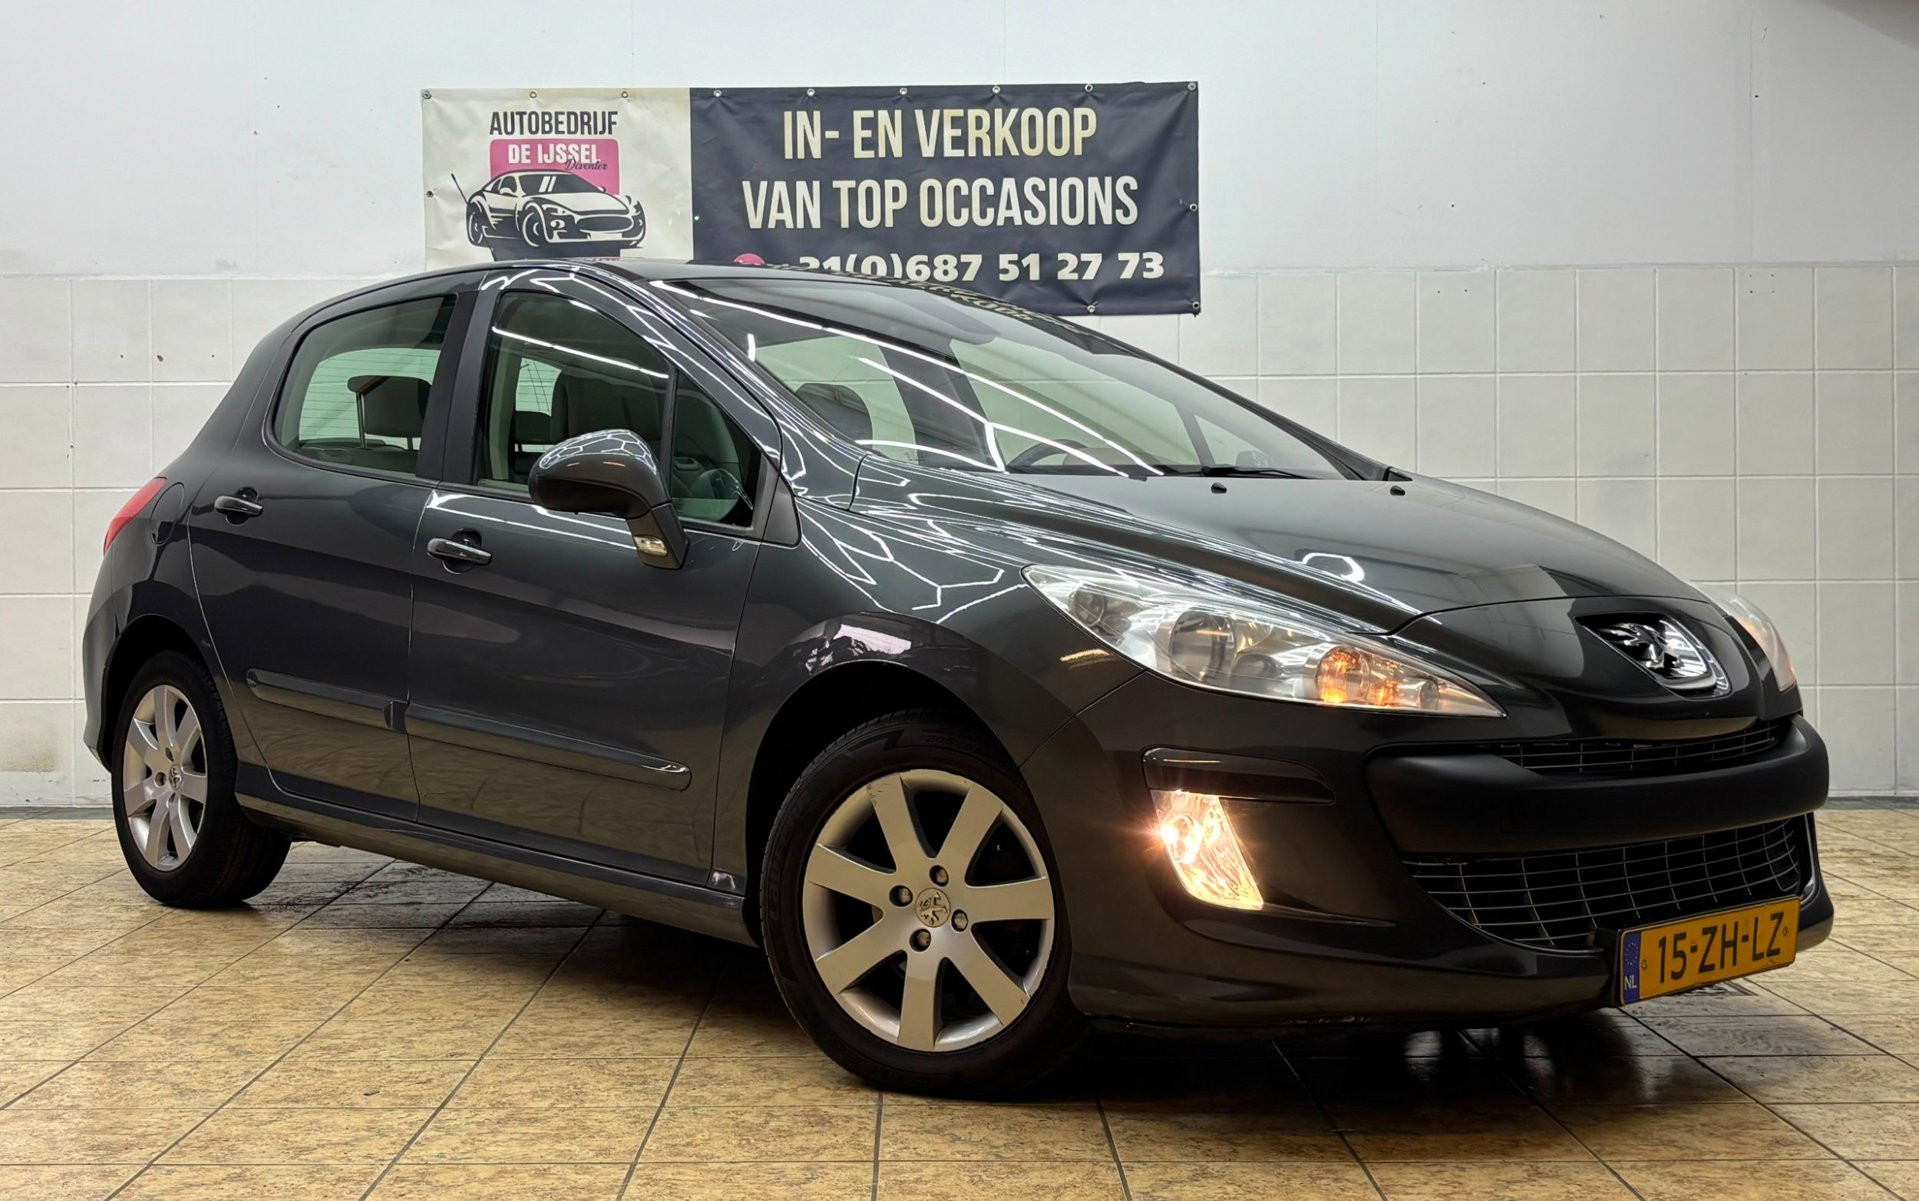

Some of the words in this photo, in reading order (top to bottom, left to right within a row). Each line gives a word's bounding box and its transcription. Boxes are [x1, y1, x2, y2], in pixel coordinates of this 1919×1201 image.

[489, 111, 618, 135] AUTOBEDRIJF
[783, 110, 840, 160] IN-
[853, 109, 903, 159] EN
[915, 107, 1098, 159] VERKOOP
[508, 144, 531, 164] DE
[537, 143, 601, 164] IJSSEL
[742, 180, 821, 229] VAN
[832, 179, 908, 229] TOP
[919, 176, 1139, 227] OCCASIONS
[999, 254, 1041, 282] 51
[1057, 253, 1104, 281] 27
[1117, 252, 1165, 280] 73
[1658, 911, 1785, 985] 15-ZH-LZ
[1624, 974, 1638, 991] NL
